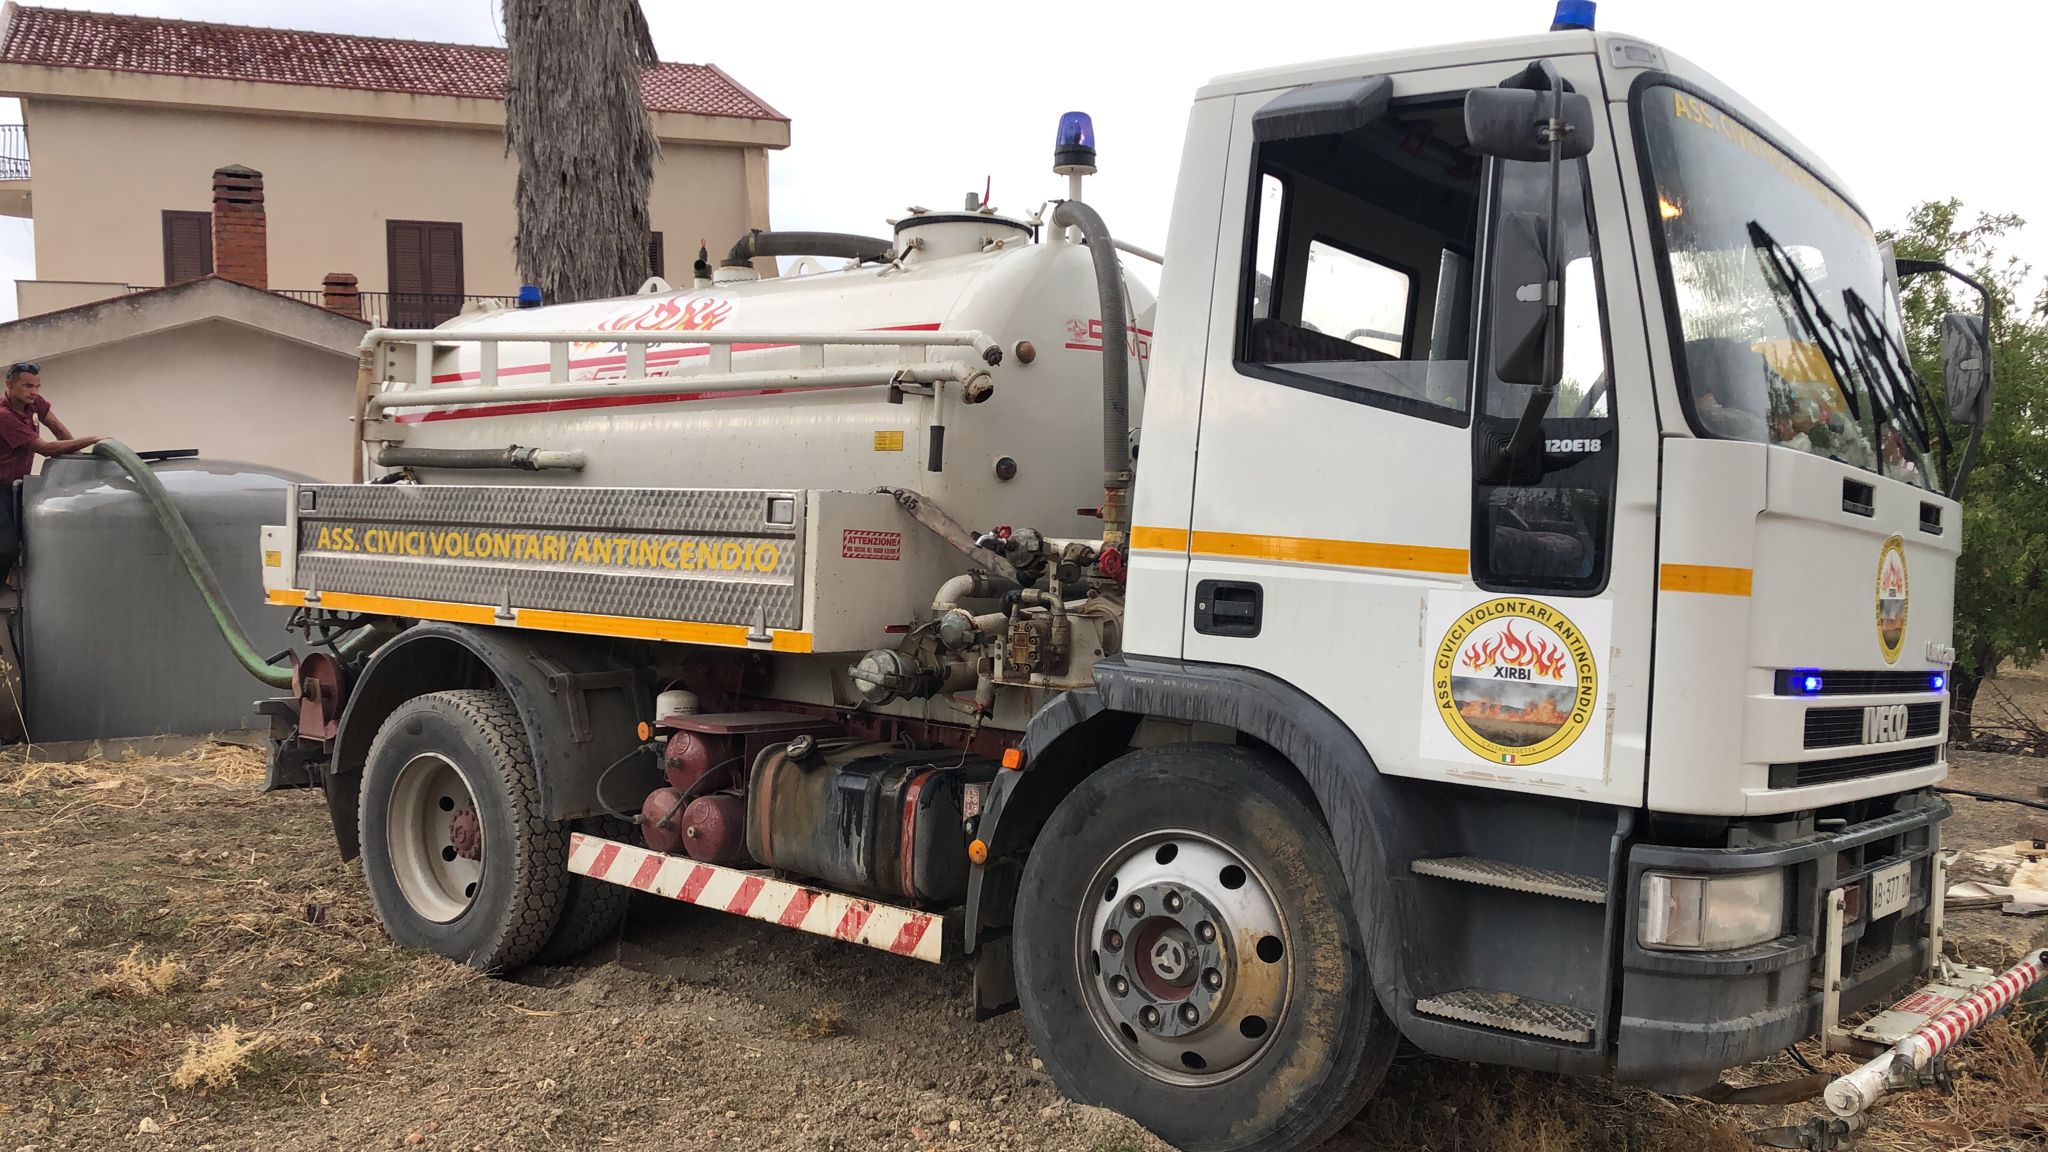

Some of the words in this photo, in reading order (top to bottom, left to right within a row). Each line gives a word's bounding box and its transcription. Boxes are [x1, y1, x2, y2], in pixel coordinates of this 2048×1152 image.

[1545, 438, 1602, 453] 120E18
[317, 527, 361, 553] ASS.
[364, 529, 426, 556] CIVICI
[430, 532, 567, 562] VOLONTARI
[572, 538, 780, 574] ANTINCENDIO
[847, 535, 897, 547] ATTENZIONE
[1466, 601, 1553, 626] VOLONTARI
[1439, 624, 1467, 669] CIVICI
[1493, 665, 1532, 681] XIRBI
[1553, 619, 1593, 725] ANTINCENDIO
[1438, 674, 1453, 710] ASS.
[1861, 704, 1908, 745] IVECO
